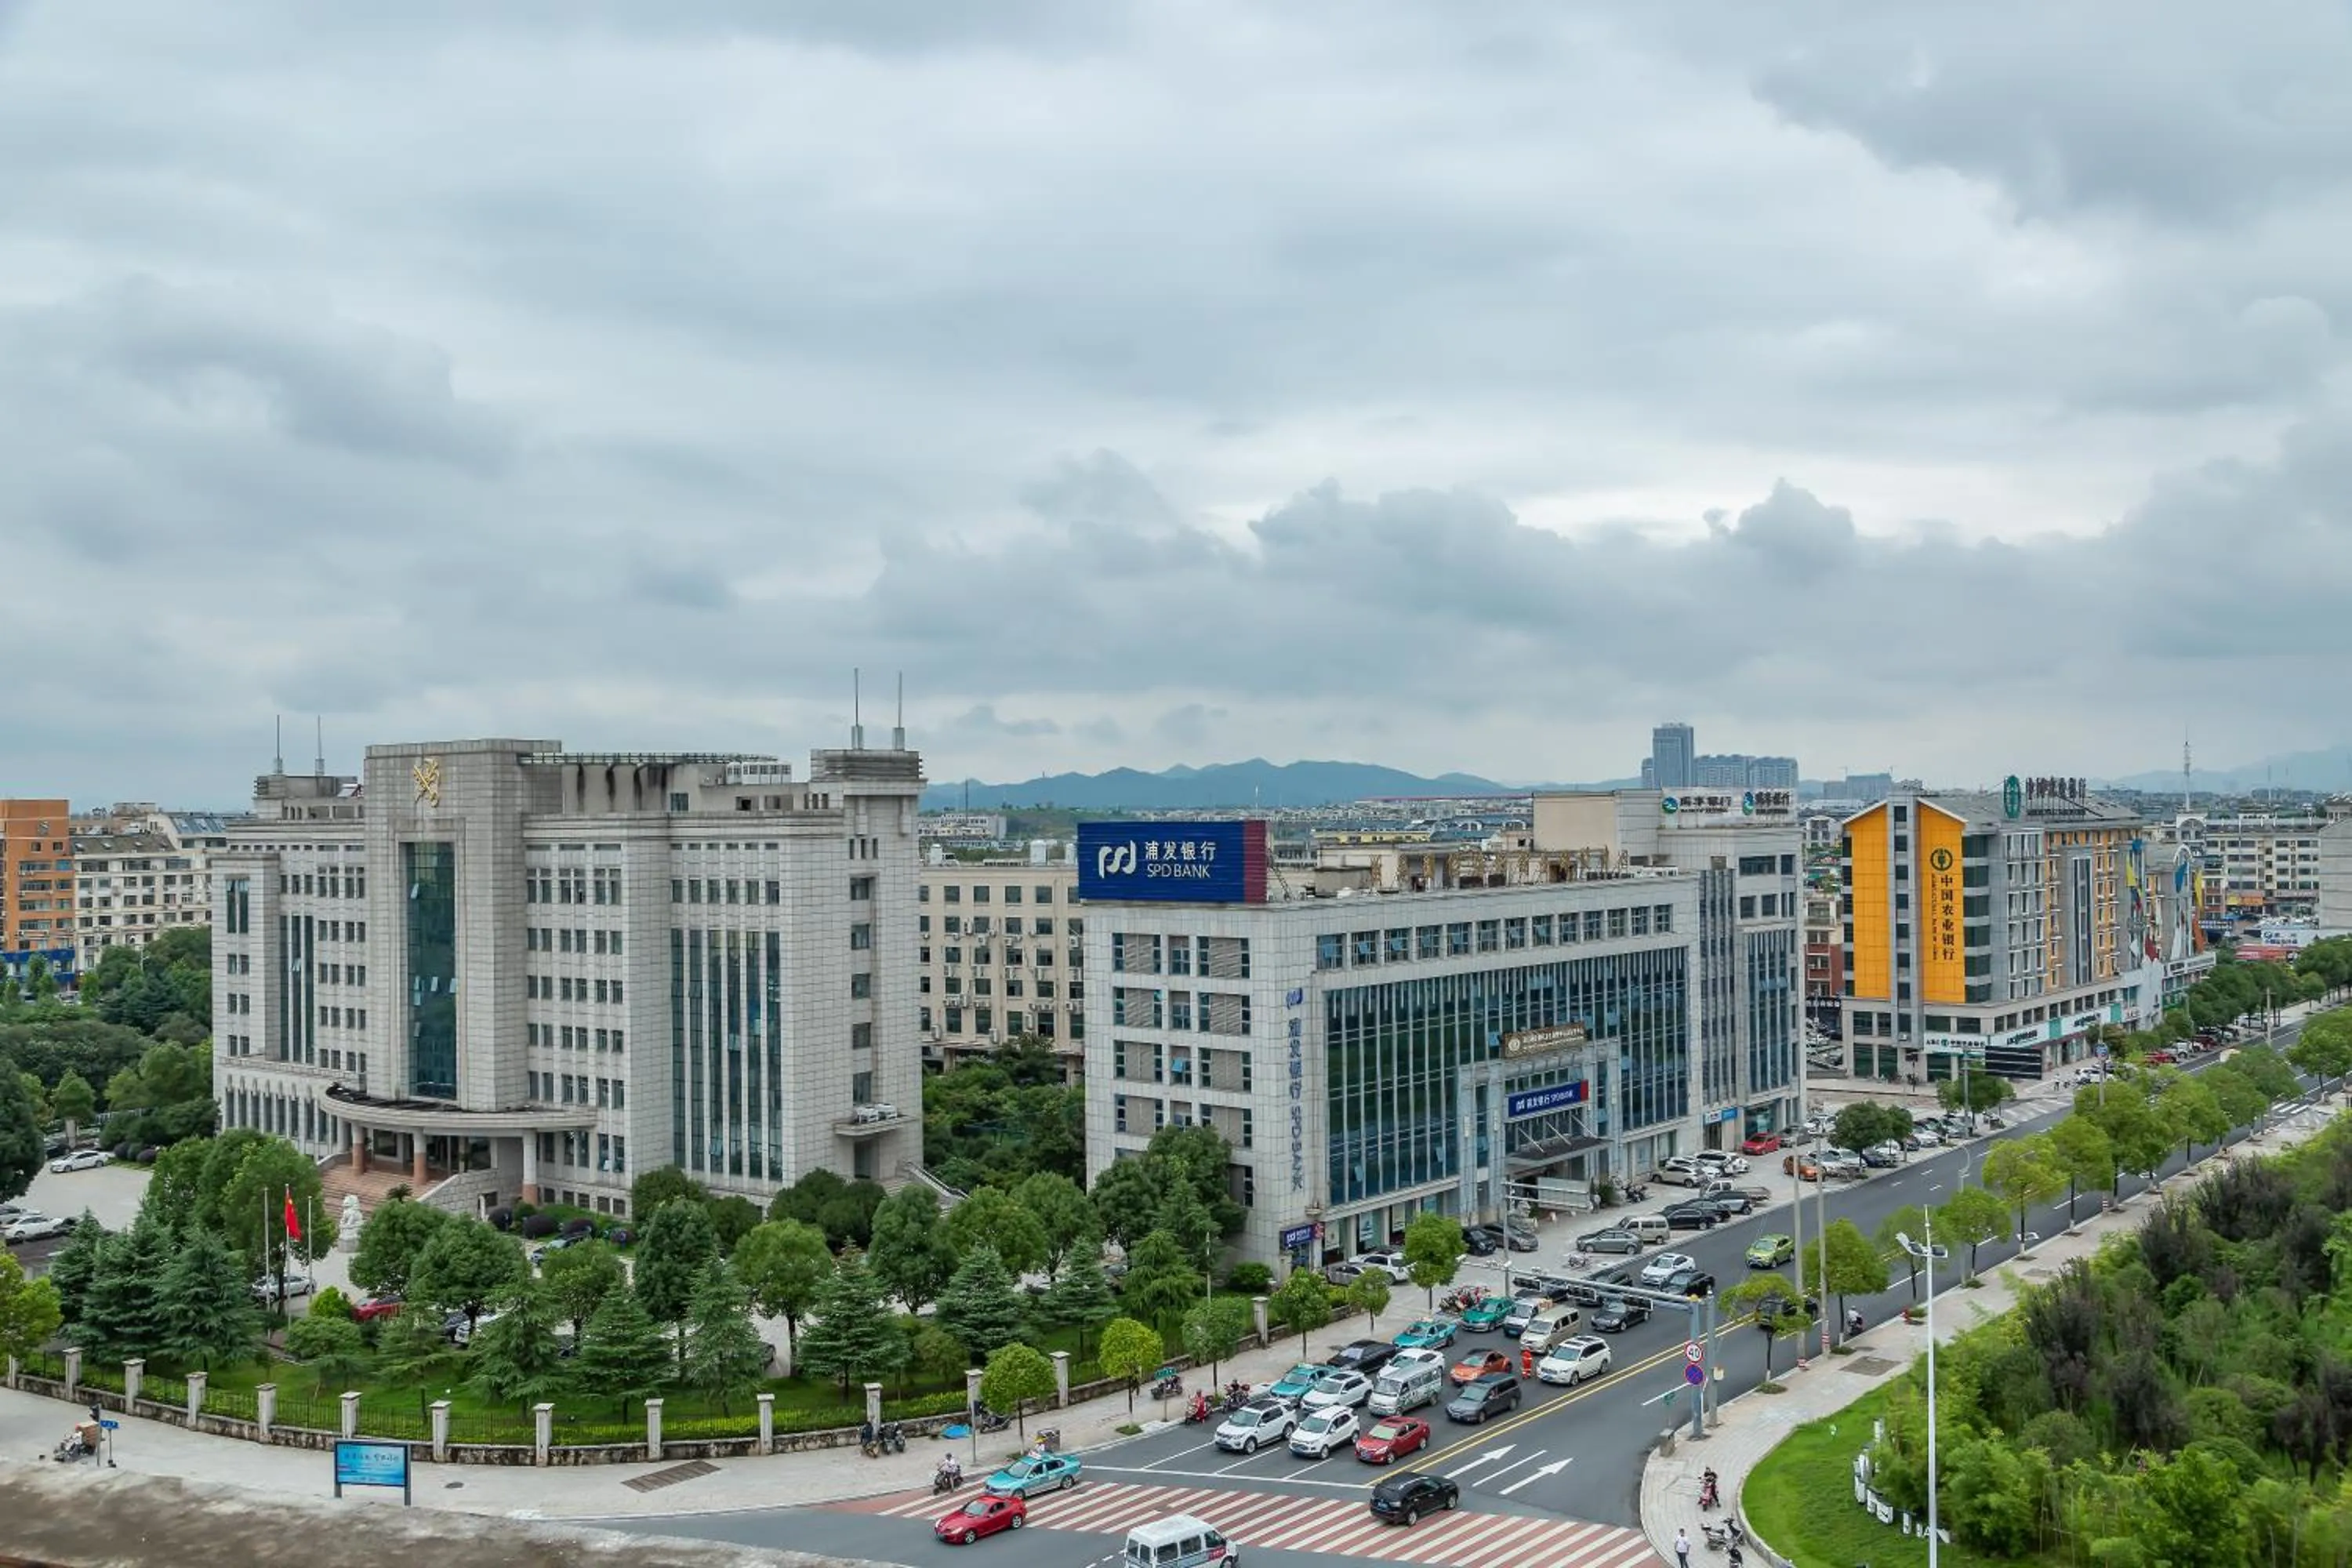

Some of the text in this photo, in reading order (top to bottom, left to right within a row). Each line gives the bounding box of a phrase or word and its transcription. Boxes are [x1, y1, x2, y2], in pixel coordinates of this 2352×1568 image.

[1145, 840, 1216, 861] 浦发银行
[1147, 863, 1210, 878] SPD BANK
[1940, 874, 1955, 960] 中国农业银行
[1688, 1348, 1700, 1359] 40
